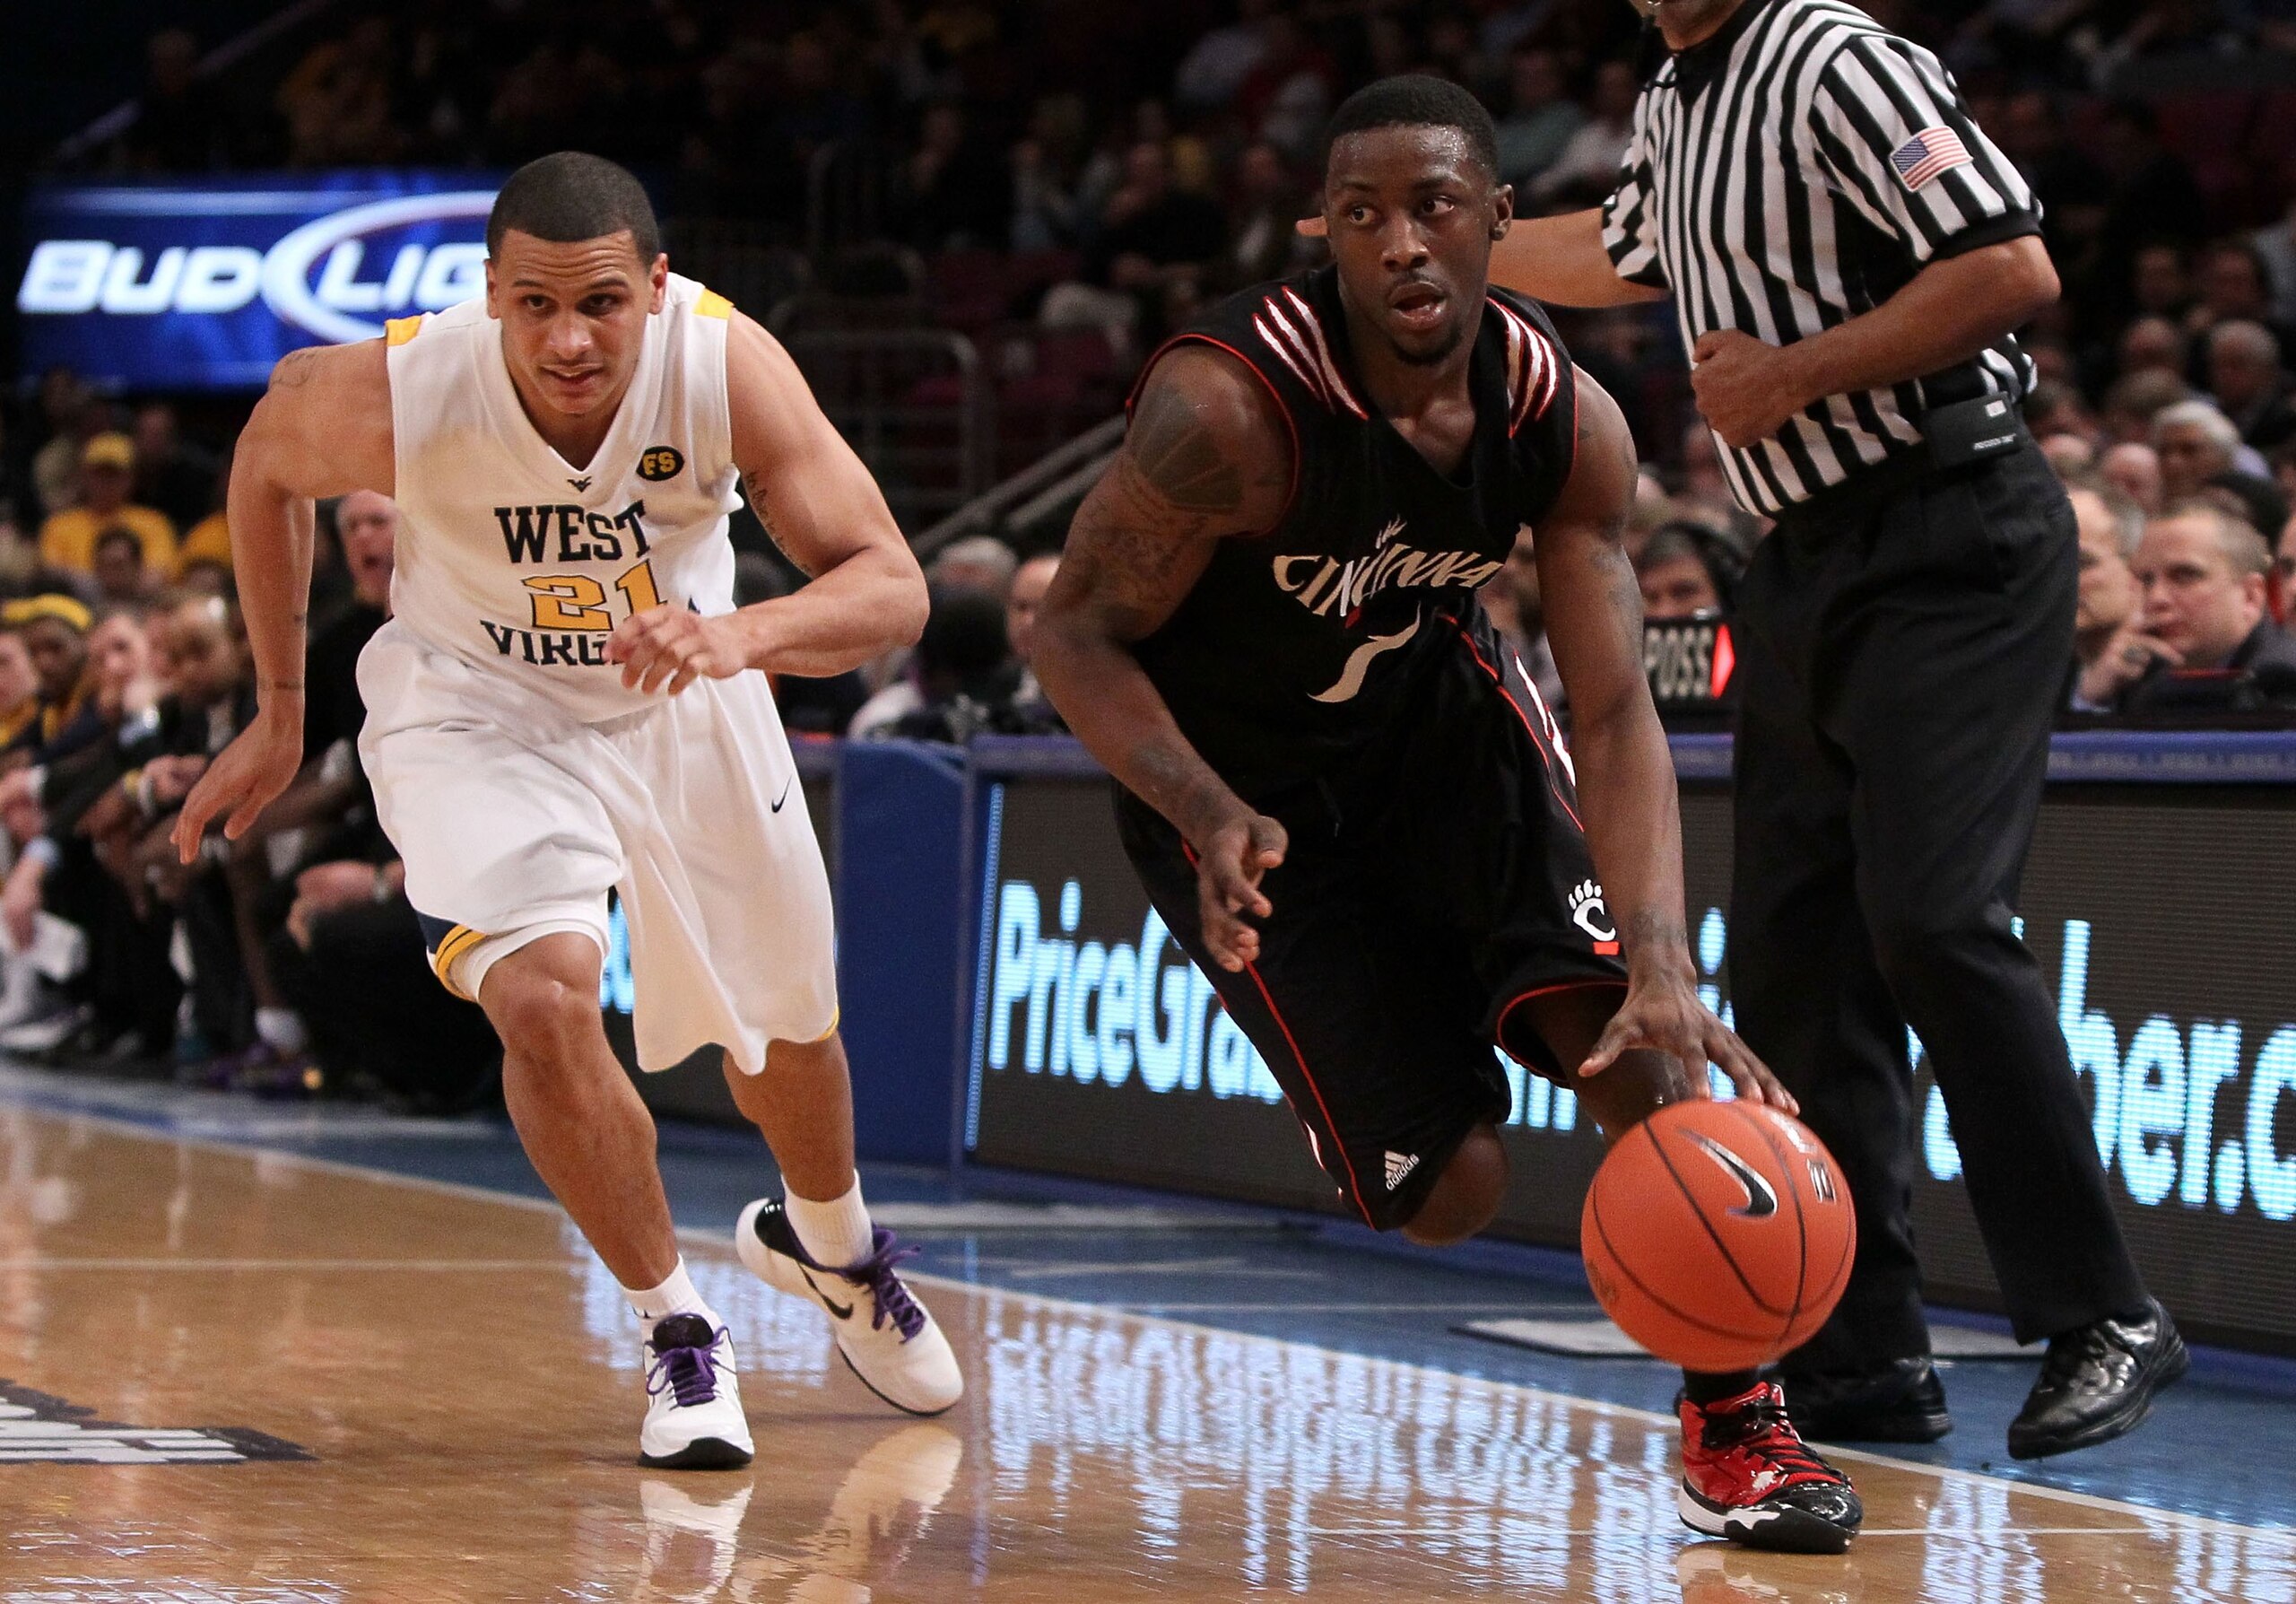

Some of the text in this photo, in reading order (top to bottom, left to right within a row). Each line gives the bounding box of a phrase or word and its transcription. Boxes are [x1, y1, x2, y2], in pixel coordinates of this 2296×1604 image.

[314, 238, 490, 312] LIG
[494, 499, 651, 564] WEST
[521, 558, 668, 632] 21
[480, 620, 625, 667] VIRG
[1645, 625, 1715, 701] POSS
[2059, 920, 2296, 1221] ber.c
[1386, 1154, 1420, 1191] adidas
